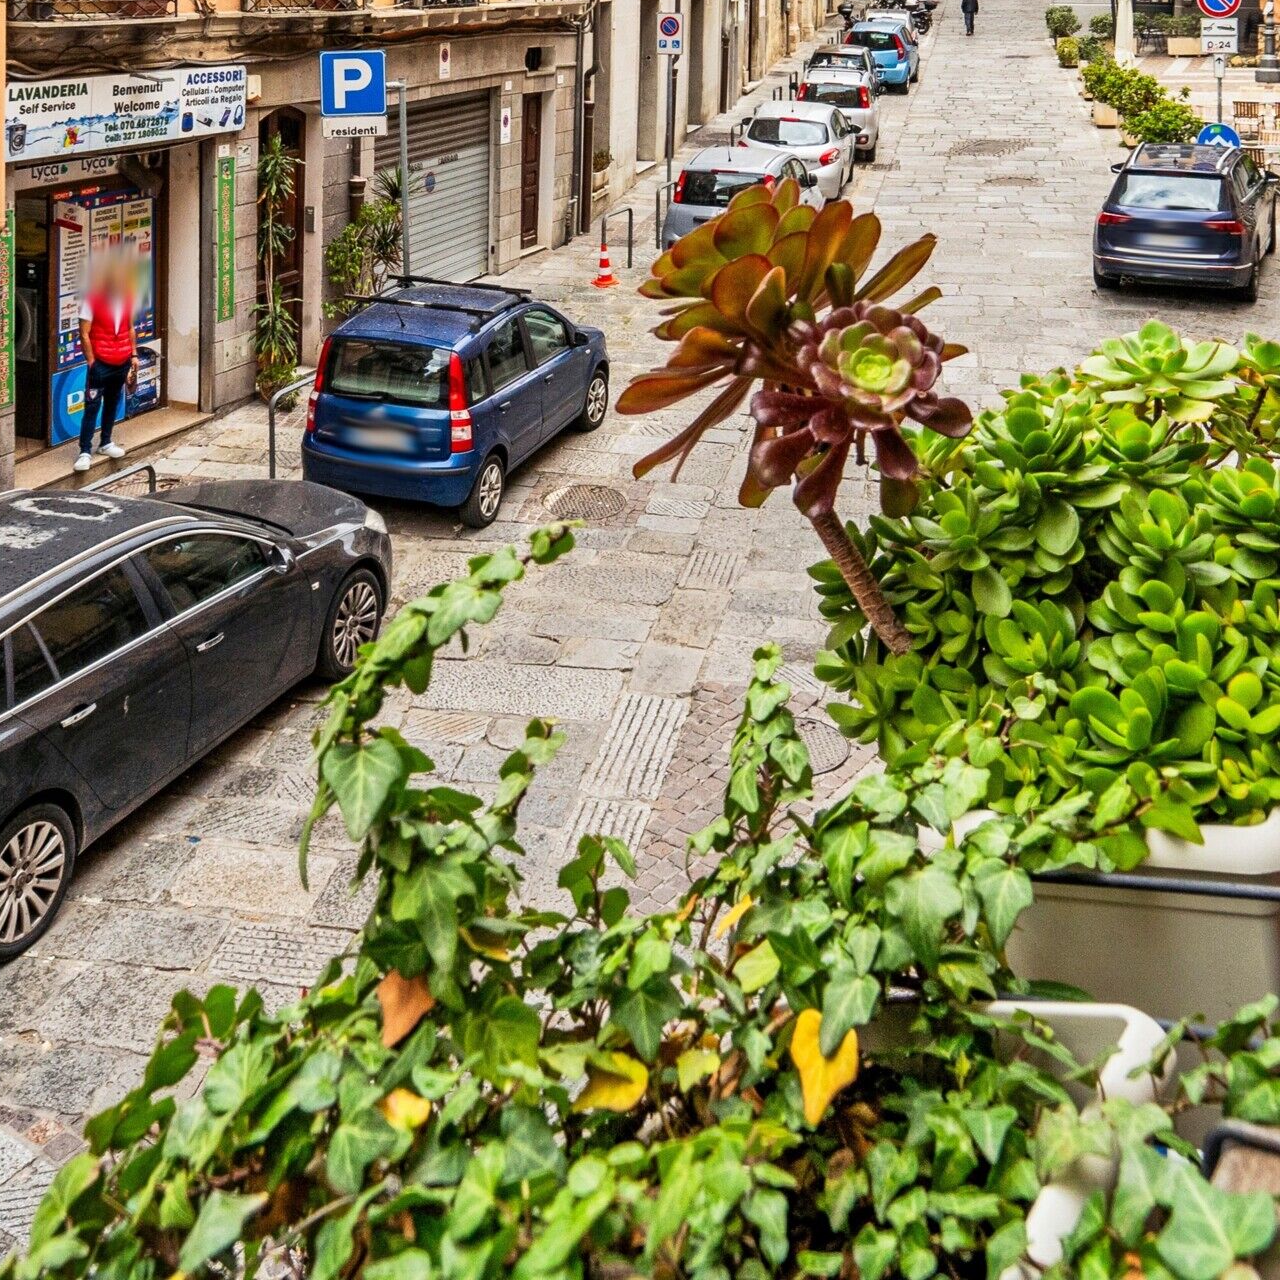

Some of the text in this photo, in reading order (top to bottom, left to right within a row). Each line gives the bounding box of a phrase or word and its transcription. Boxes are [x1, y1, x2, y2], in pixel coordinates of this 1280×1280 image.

[186, 70, 242, 86] ACCESSORI
[333, 58, 373, 109] P
[8, 83, 88, 102] LAVANDERIA
[112, 82, 163, 97] Benvenuti
[182, 86, 210, 97] Cellulari
[214, 84, 245, 95] Computer
[19, 100, 76, 115] Self Service
[114, 100, 160, 114] Welcome
[185, 93, 242, 107] Articoli da Regalo
[120, 120, 135, 131] 070
[331, 126, 378, 137] residenti
[123, 131, 136, 141] 327
[81, 156, 107, 172] Lyca
[31, 164, 59, 181] Lyca
